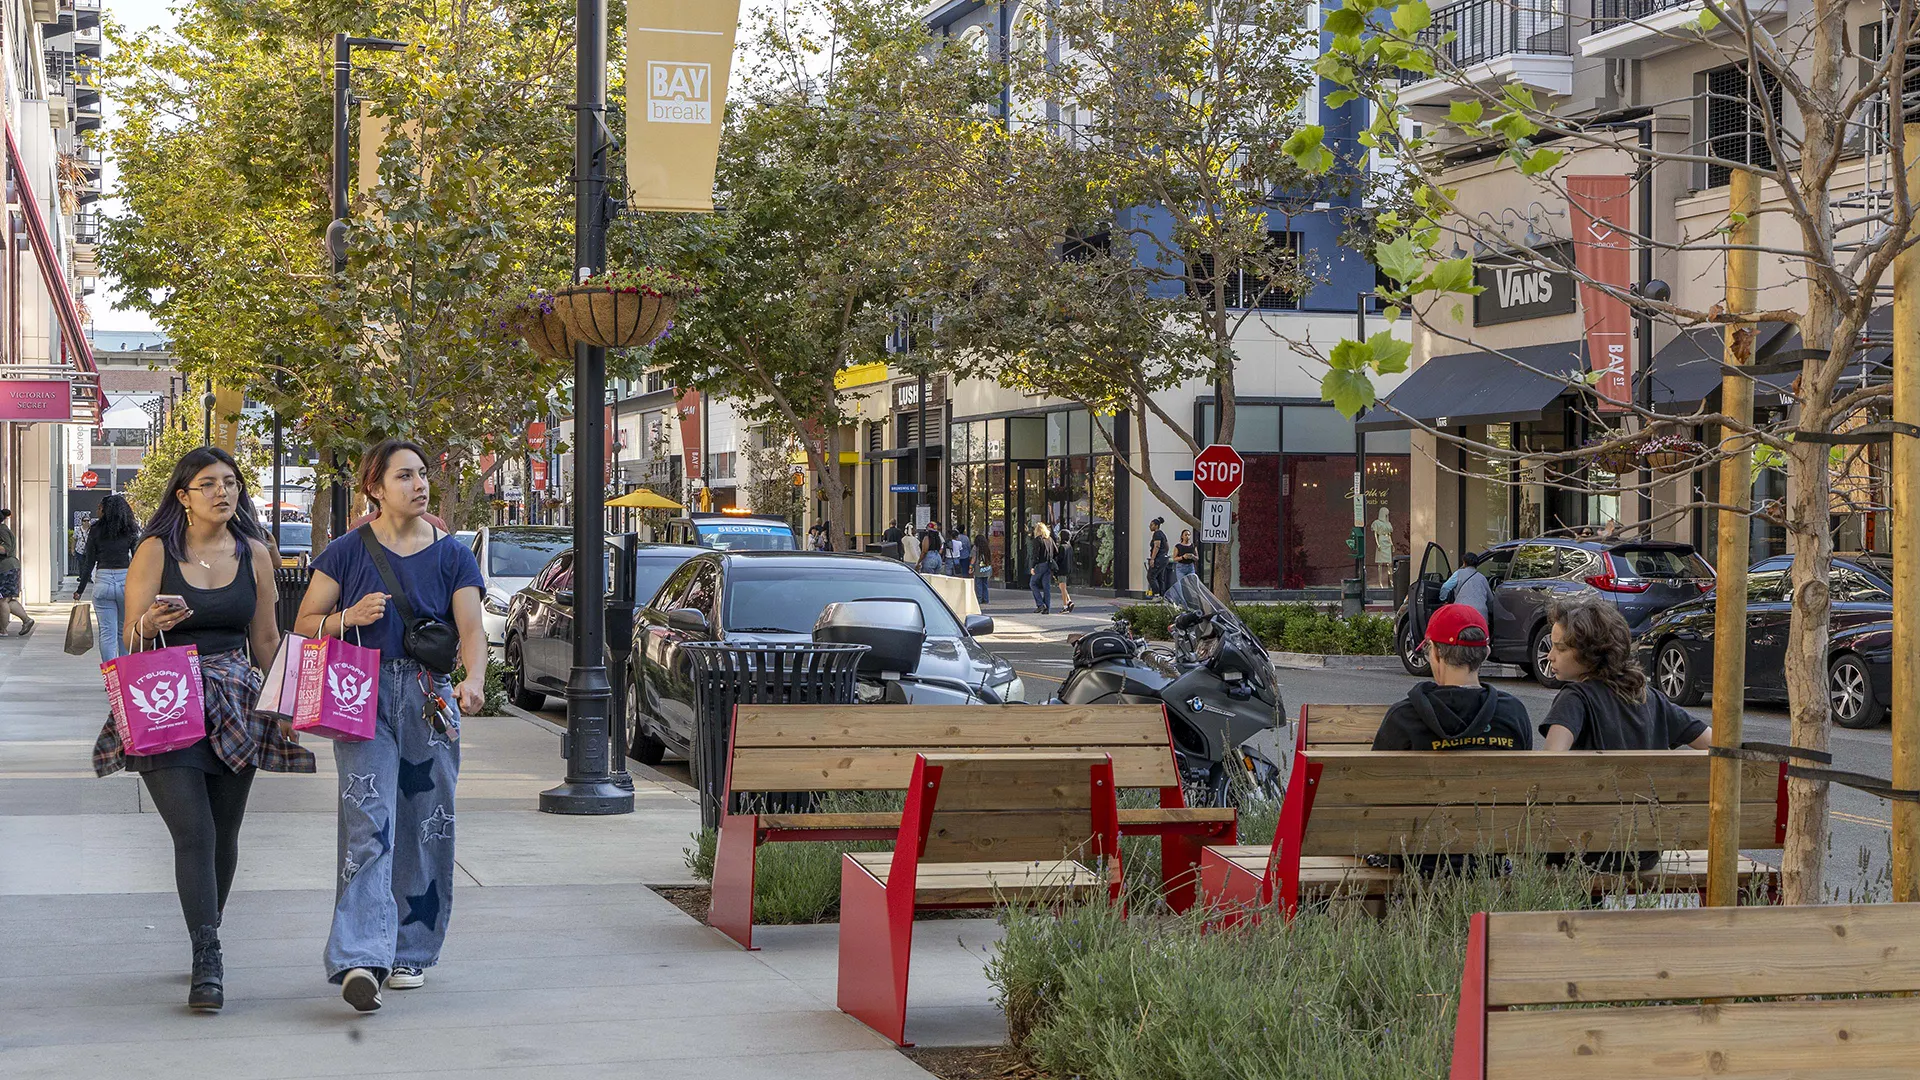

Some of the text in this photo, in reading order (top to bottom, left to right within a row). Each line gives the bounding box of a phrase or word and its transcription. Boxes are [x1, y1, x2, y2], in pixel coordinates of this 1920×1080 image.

[653, 66, 706, 98] BAY
[653, 102, 706, 120] break
[1496, 268, 1553, 308] VANS
[1608, 344, 1624, 375] BAY
[9, 391, 56, 399] VICTORIA'S
[898, 385, 919, 406] LUSH
[220, 424, 228, 440] BAY
[1197, 461, 1240, 482] STOP
[1211, 504, 1224, 513] NO
[1212, 514, 1221, 528] U
[718, 526, 772, 534] SECURITY
[1204, 529, 1228, 538] TURN
[1432, 736, 1514, 750] PACIFIC PIPE
